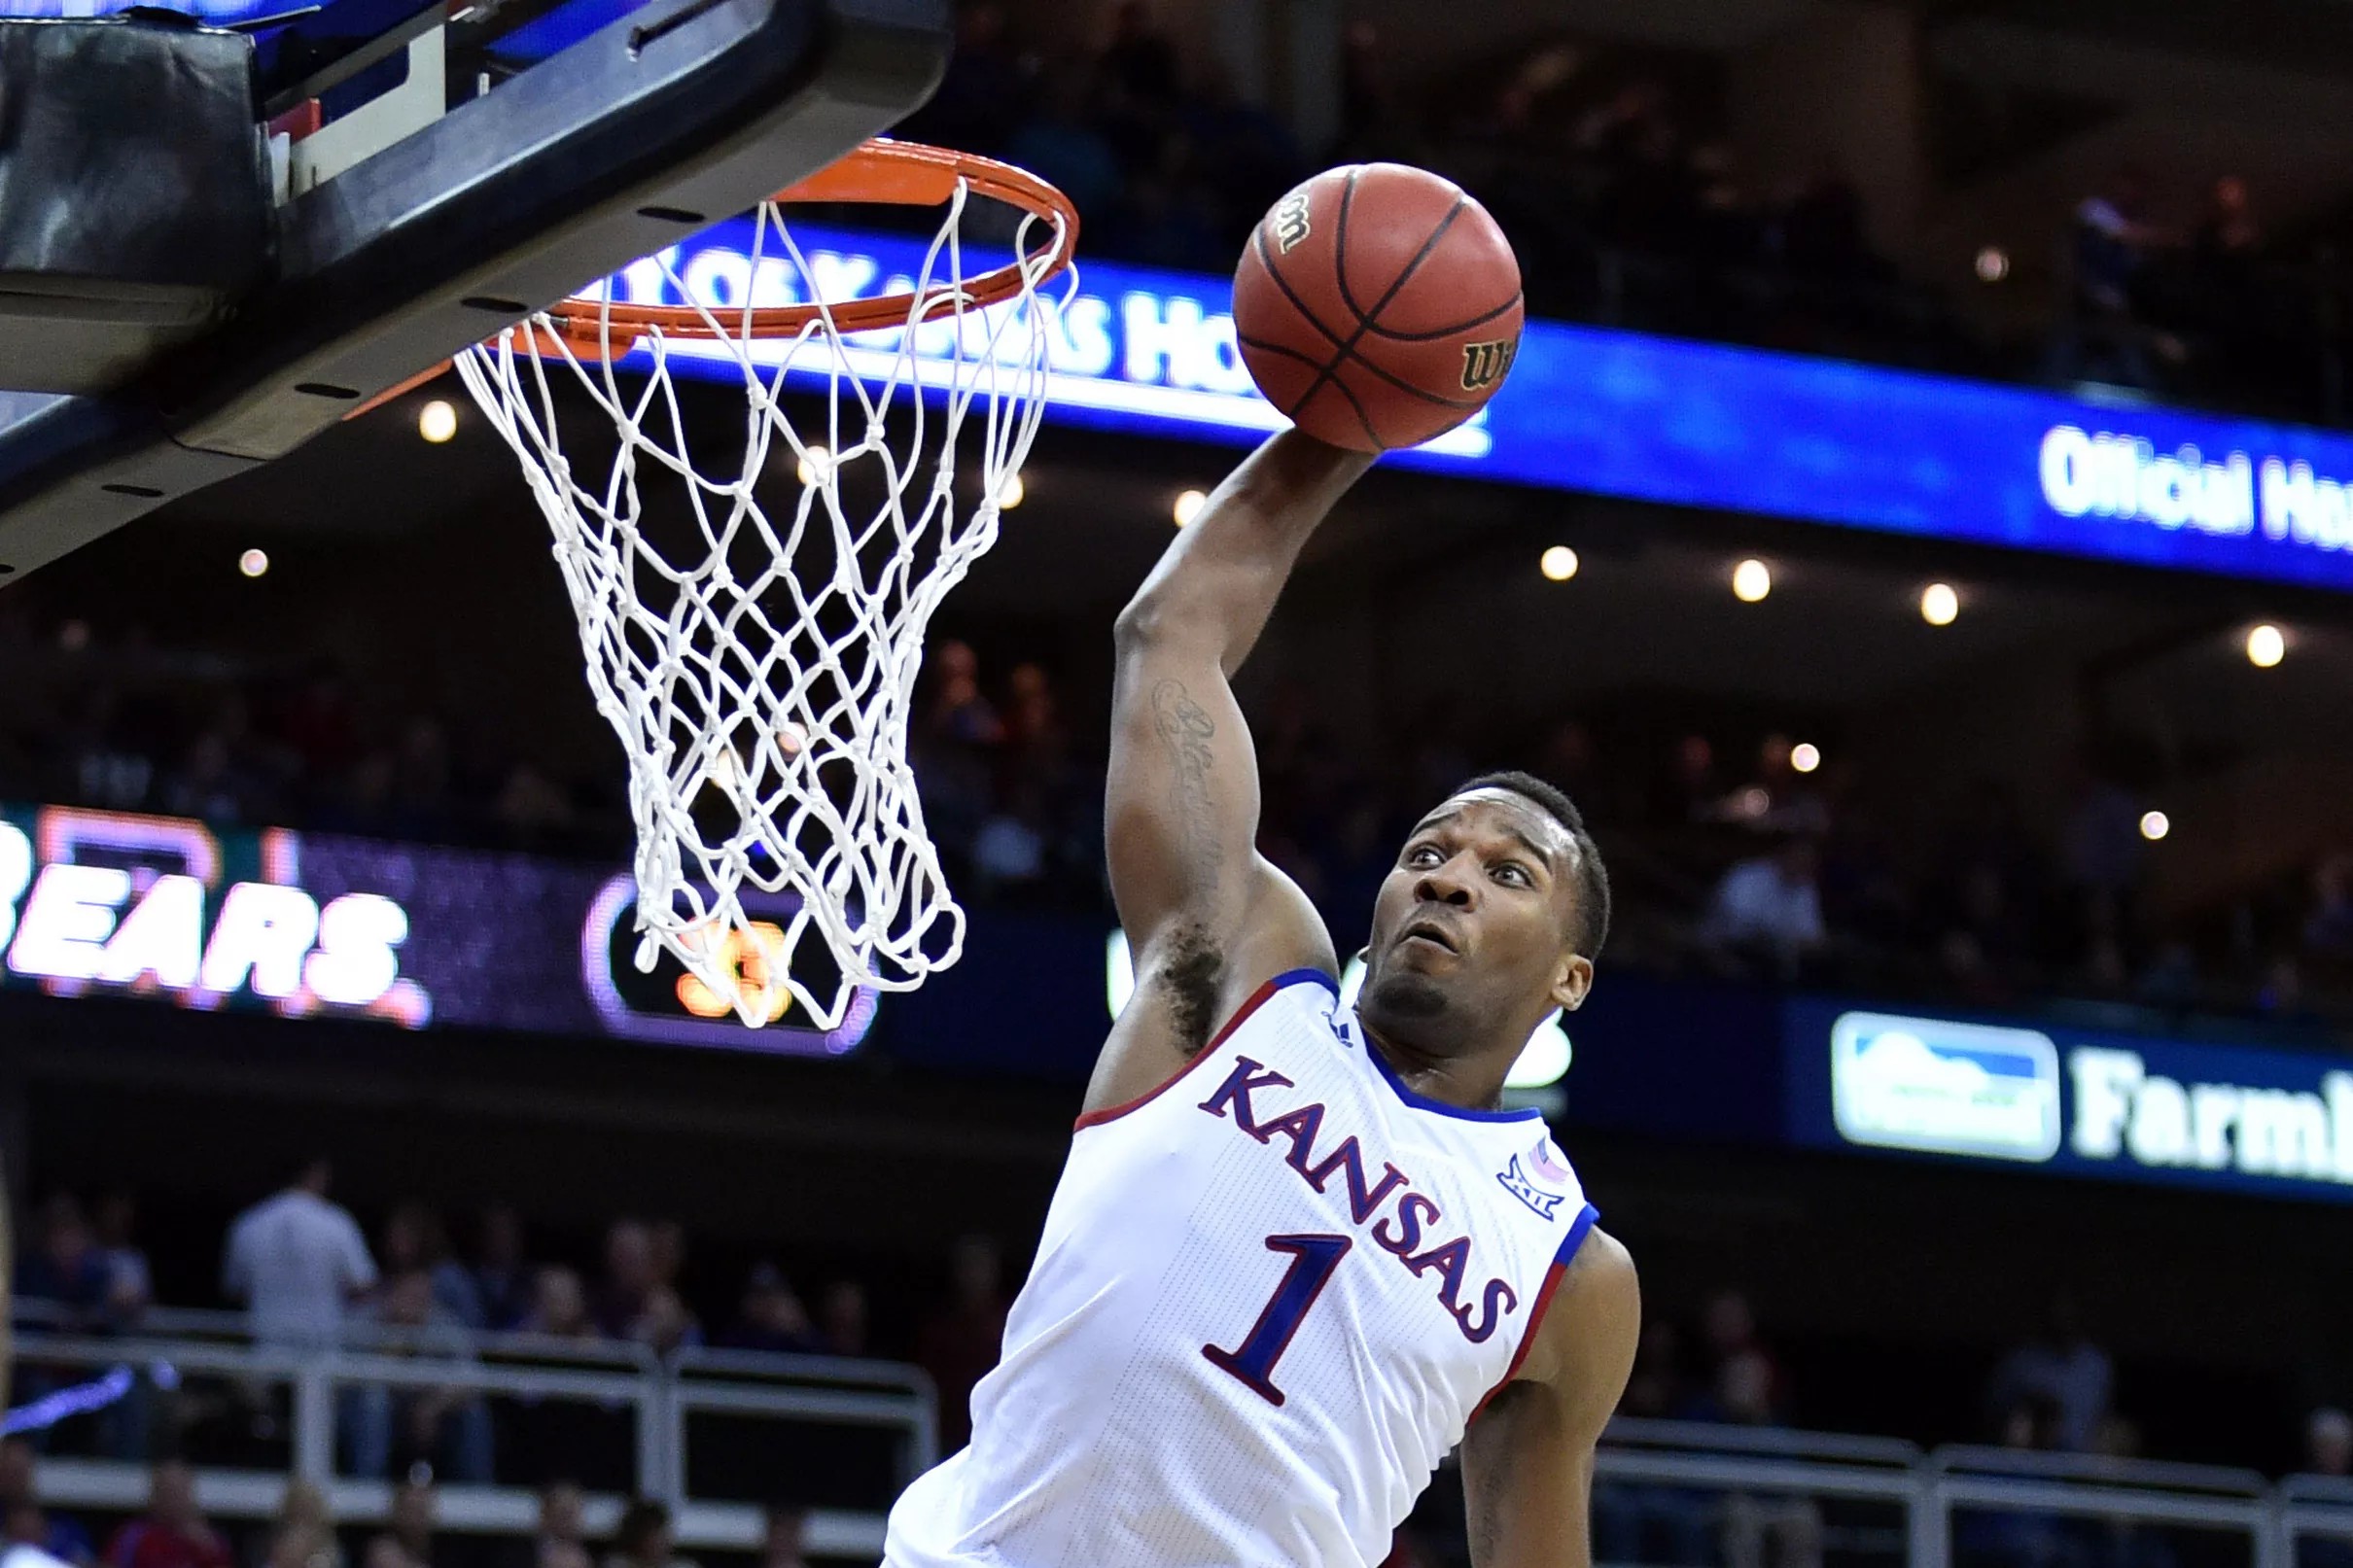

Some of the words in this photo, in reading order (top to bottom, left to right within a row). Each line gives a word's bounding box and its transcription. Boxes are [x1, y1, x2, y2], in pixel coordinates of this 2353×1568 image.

[0, 821, 408, 1005] EARS
[1198, 1054, 1518, 1343] KANSAS
[1201, 1234, 1352, 1407] 1
